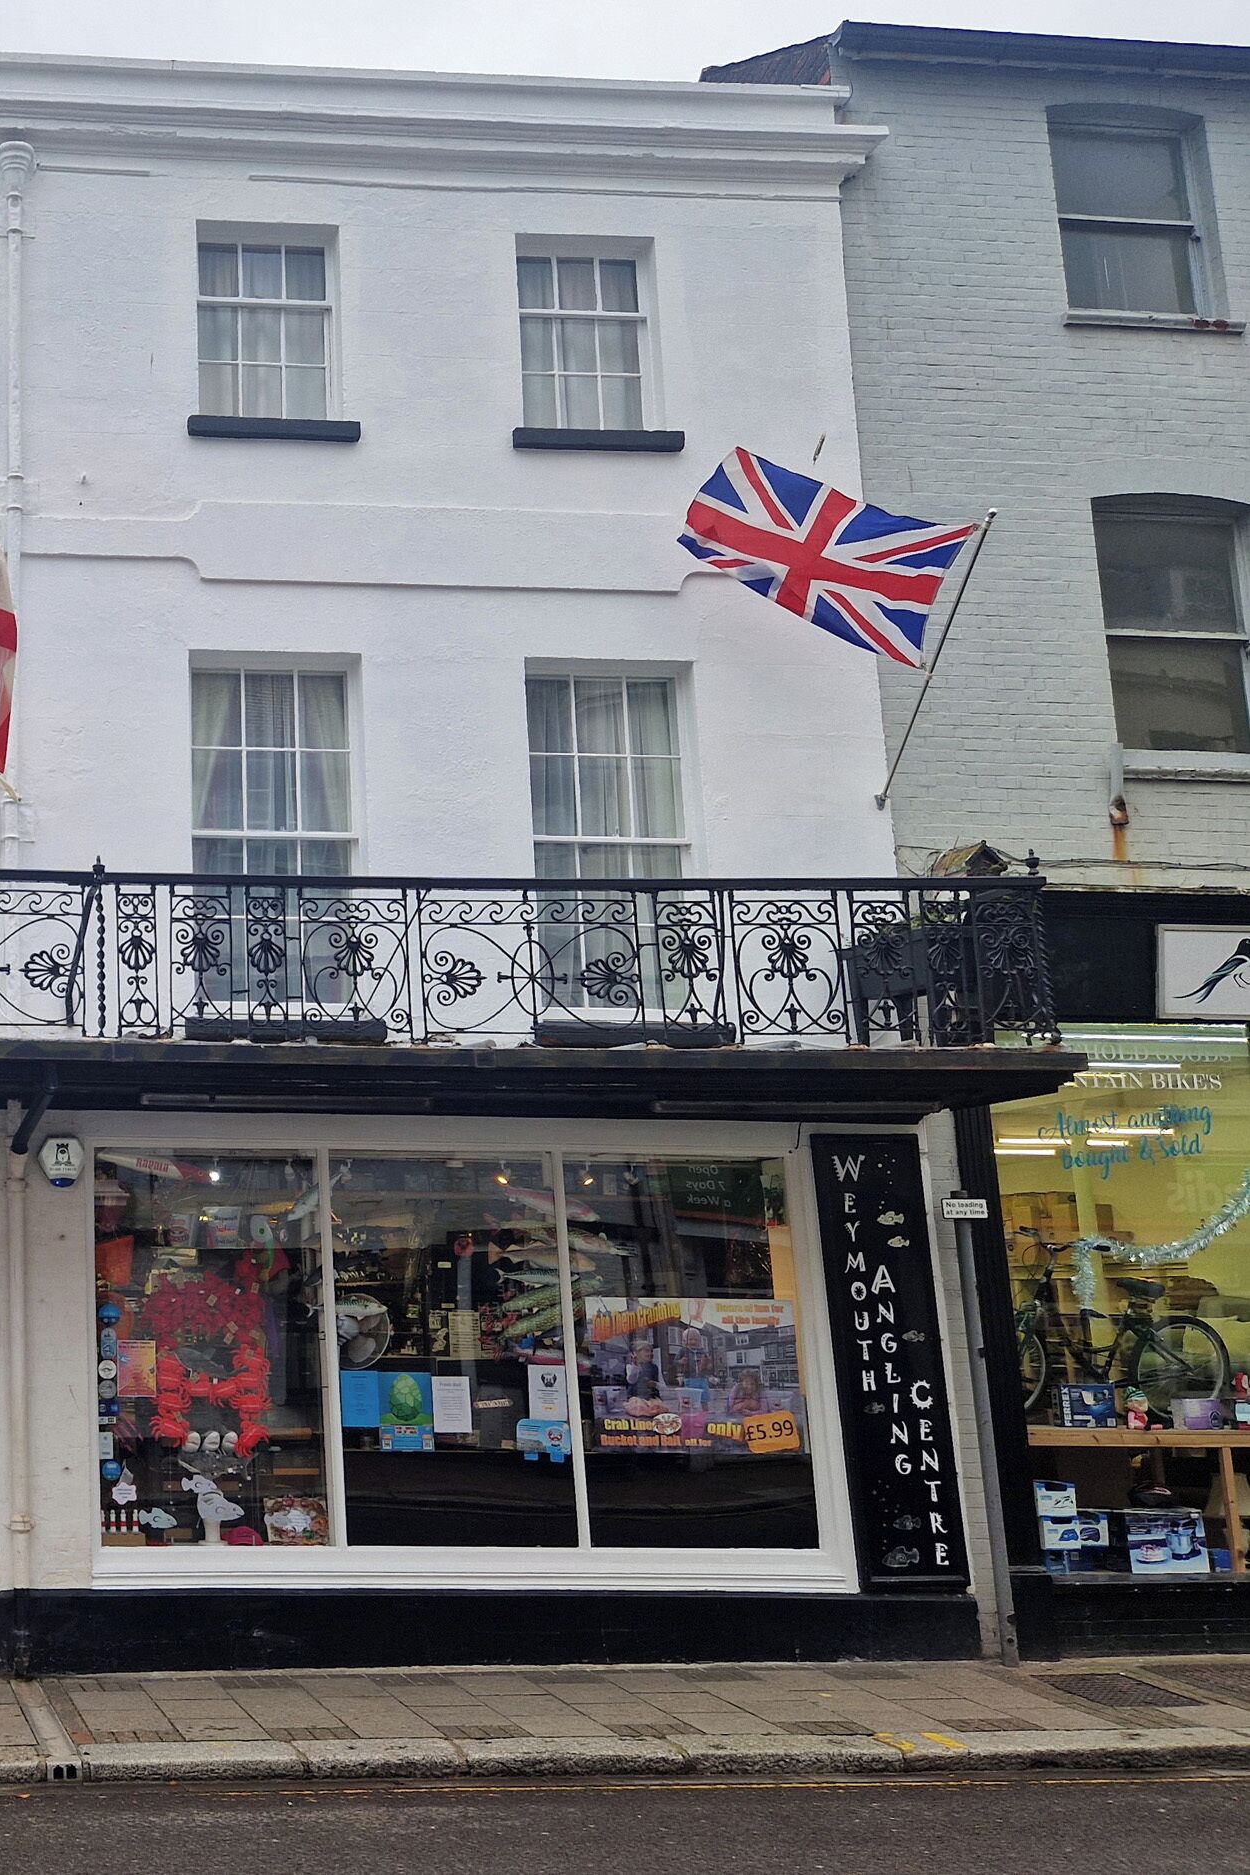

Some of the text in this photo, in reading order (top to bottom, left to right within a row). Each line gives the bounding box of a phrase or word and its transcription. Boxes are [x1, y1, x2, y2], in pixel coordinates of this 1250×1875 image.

[1152, 1073, 1223, 1091] BIKE'S
[831, 1154, 877, 1393] WEYMOUTH
[871, 1264, 912, 1476] ANGLING
[1060, 1385, 1073, 1427] FERREX
[604, 1418, 630, 1430] Crab
[707, 1421, 743, 1442] only
[745, 1419, 795, 1442] £5.99
[639, 1435, 659, 1446] and
[661, 1434, 681, 1446] Bait
[909, 1380, 950, 1567] CENTRE
